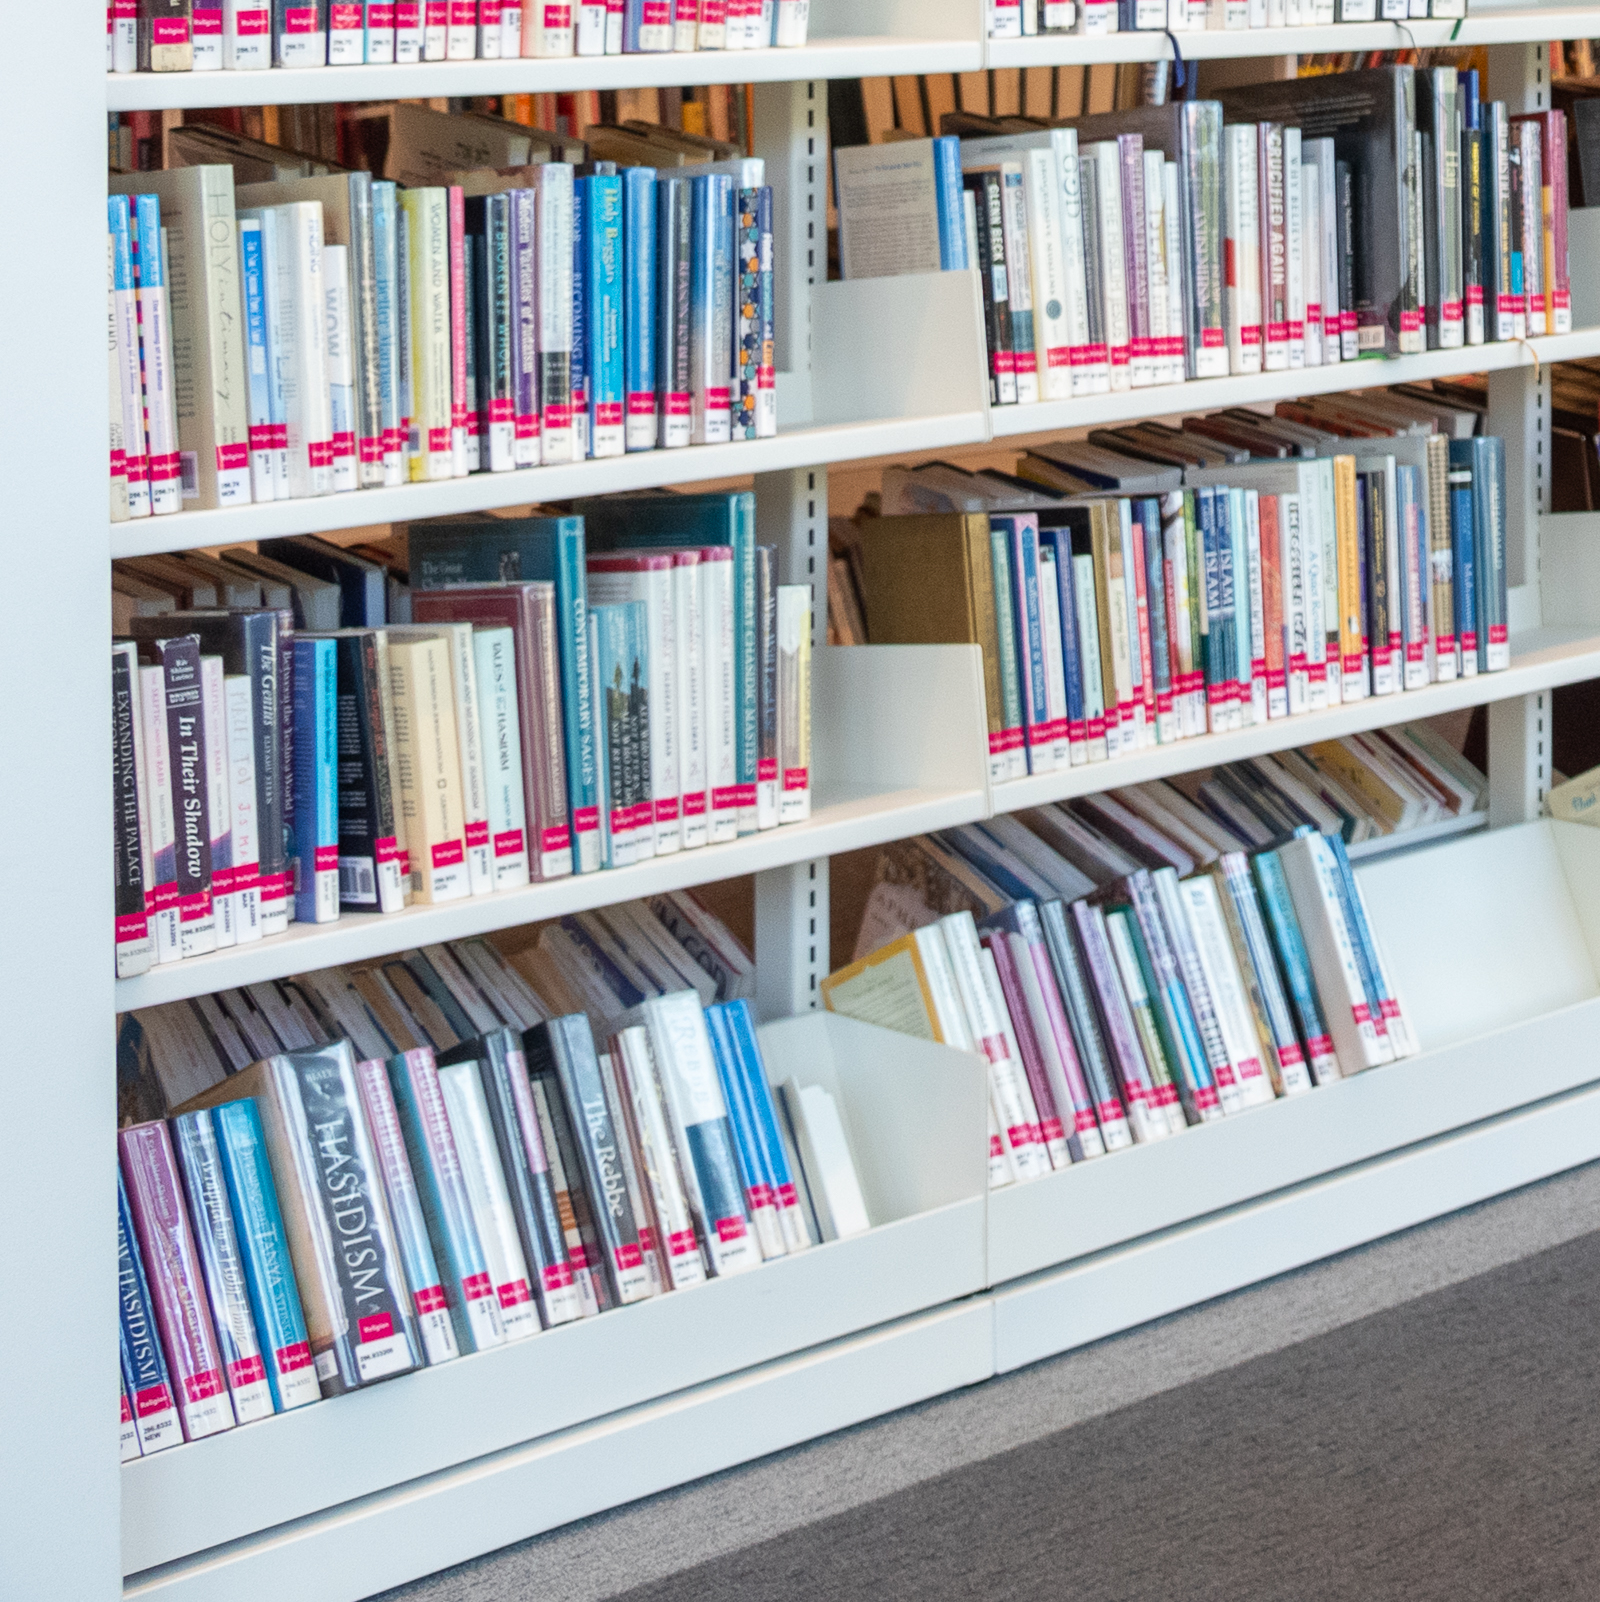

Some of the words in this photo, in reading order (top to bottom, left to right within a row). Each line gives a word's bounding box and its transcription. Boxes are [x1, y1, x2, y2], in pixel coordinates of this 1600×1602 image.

[158, 26, 186, 36] Religion
[1062, 154, 1081, 219] GOD
[1270, 130, 1283, 229] CRUCIFIED
[209, 193, 231, 275] HOLY
[991, 224, 1005, 262] BECK
[1271, 231, 1285, 286] AGAIN
[1205, 552, 1220, 609] ISLAM
[1219, 549, 1235, 607] ISLAM
[574, 597, 592, 734] CONTEMPORARY
[117, 690, 134, 788] EXPANDING
[178, 716, 196, 739] In
[180, 743, 196, 798] Their
[581, 736, 594, 786] SAGES
[122, 793, 136, 819] THE
[124, 822, 142, 887] PALACE
[183, 801, 202, 878] Shadow
[118, 921, 146, 934] Religion
[583, 1093, 606, 1144] The
[593, 1145, 624, 1218] Rebbe
[314, 1121, 384, 1306] HASIDISM
[121, 1274, 151, 1382] HASIDISM
[363, 1320, 390, 1333] Religion
[139, 1394, 170, 1410] Religion
